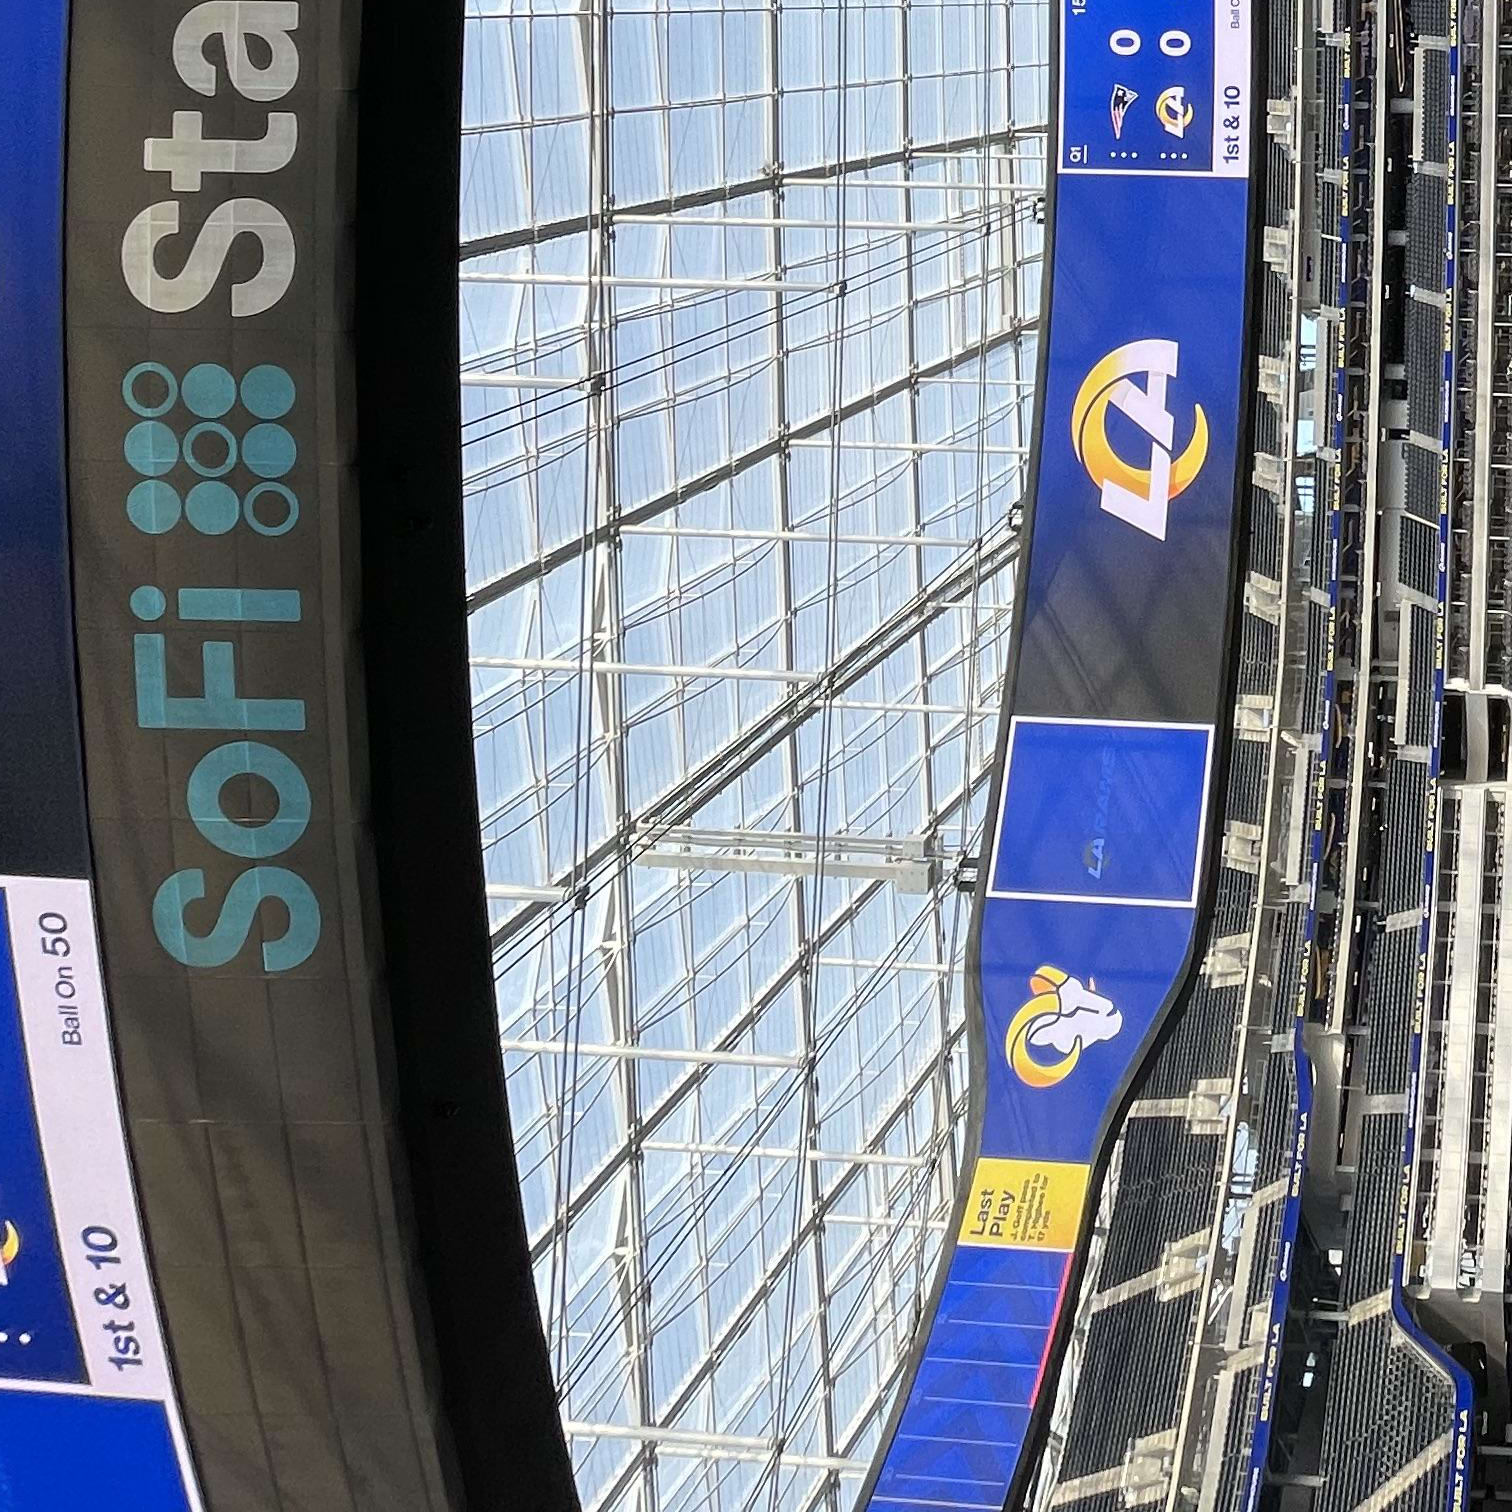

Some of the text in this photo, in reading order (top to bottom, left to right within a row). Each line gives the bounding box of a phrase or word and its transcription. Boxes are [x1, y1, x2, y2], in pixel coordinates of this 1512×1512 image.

[1109, 28, 1142, 56] 0
[1230, 10, 1240, 29] Ball
[1159, 30, 1192, 57] 0
[1222, 86, 1240, 164] 1st & 10
[1070, 146, 1081, 162] Q1
[130, 585, 321, 972] SoFi
[38, 912, 83, 1046] Ball On 50
[970, 1189, 995, 1236] Last
[989, 1190, 1015, 1237] Play
[81, 1224, 144, 1372] 1st & 10
[1260, 1323, 1280, 1421] BUILT FOR LA
